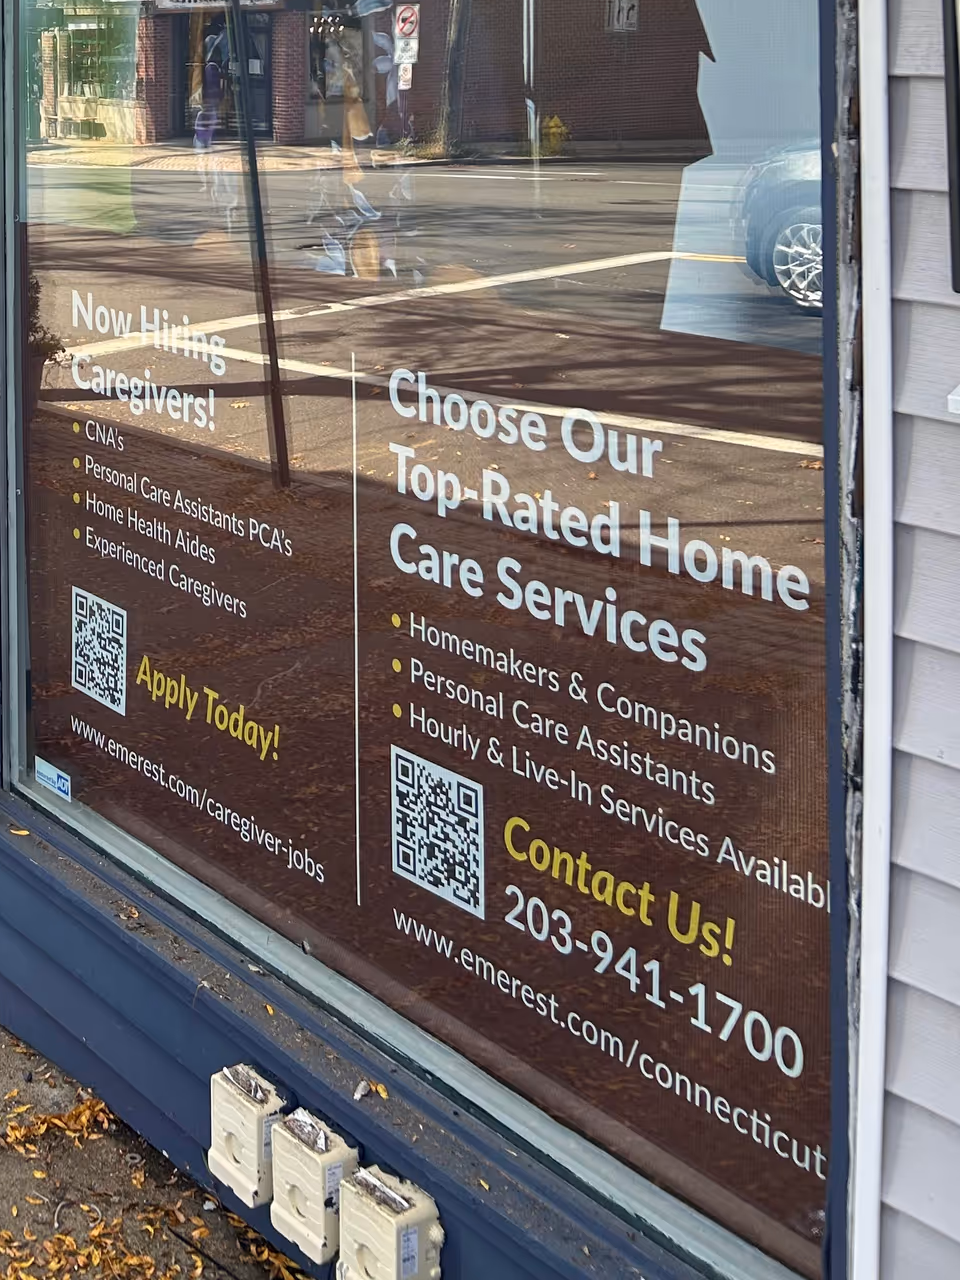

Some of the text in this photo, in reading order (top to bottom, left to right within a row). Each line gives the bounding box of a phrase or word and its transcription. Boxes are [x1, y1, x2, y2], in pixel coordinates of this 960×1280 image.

[71, 354, 215, 432] Caregivers!
[72, 290, 226, 376] Now Hiring
[85, 420, 124, 451] CNA's
[388, 368, 663, 478] Choose Our
[85, 455, 293, 556] Personal Care Assistants PCA's
[86, 490, 216, 564] Home Health Aides
[86, 526, 247, 618] Experienced Caregivers
[389, 443, 811, 611] Top-Rated Home
[390, 523, 708, 672] Care Services
[136, 655, 280, 761] Apply Today!
[409, 612, 776, 774] Homemakers & Companions
[410, 658, 716, 805] Personal Care Assistants
[70, 715, 325, 883] www.emerest.com/caregiver-jobs
[409, 702, 480, 760] Hourly
[487, 737, 505, 767] &
[512, 746, 592, 806] Live-In
[600, 784, 709, 857] Services
[503, 816, 735, 967] Contact Us!
[392, 908, 827, 1181] www.emerest.com/connecticut
[504, 885, 804, 1079] 203-941-1700
